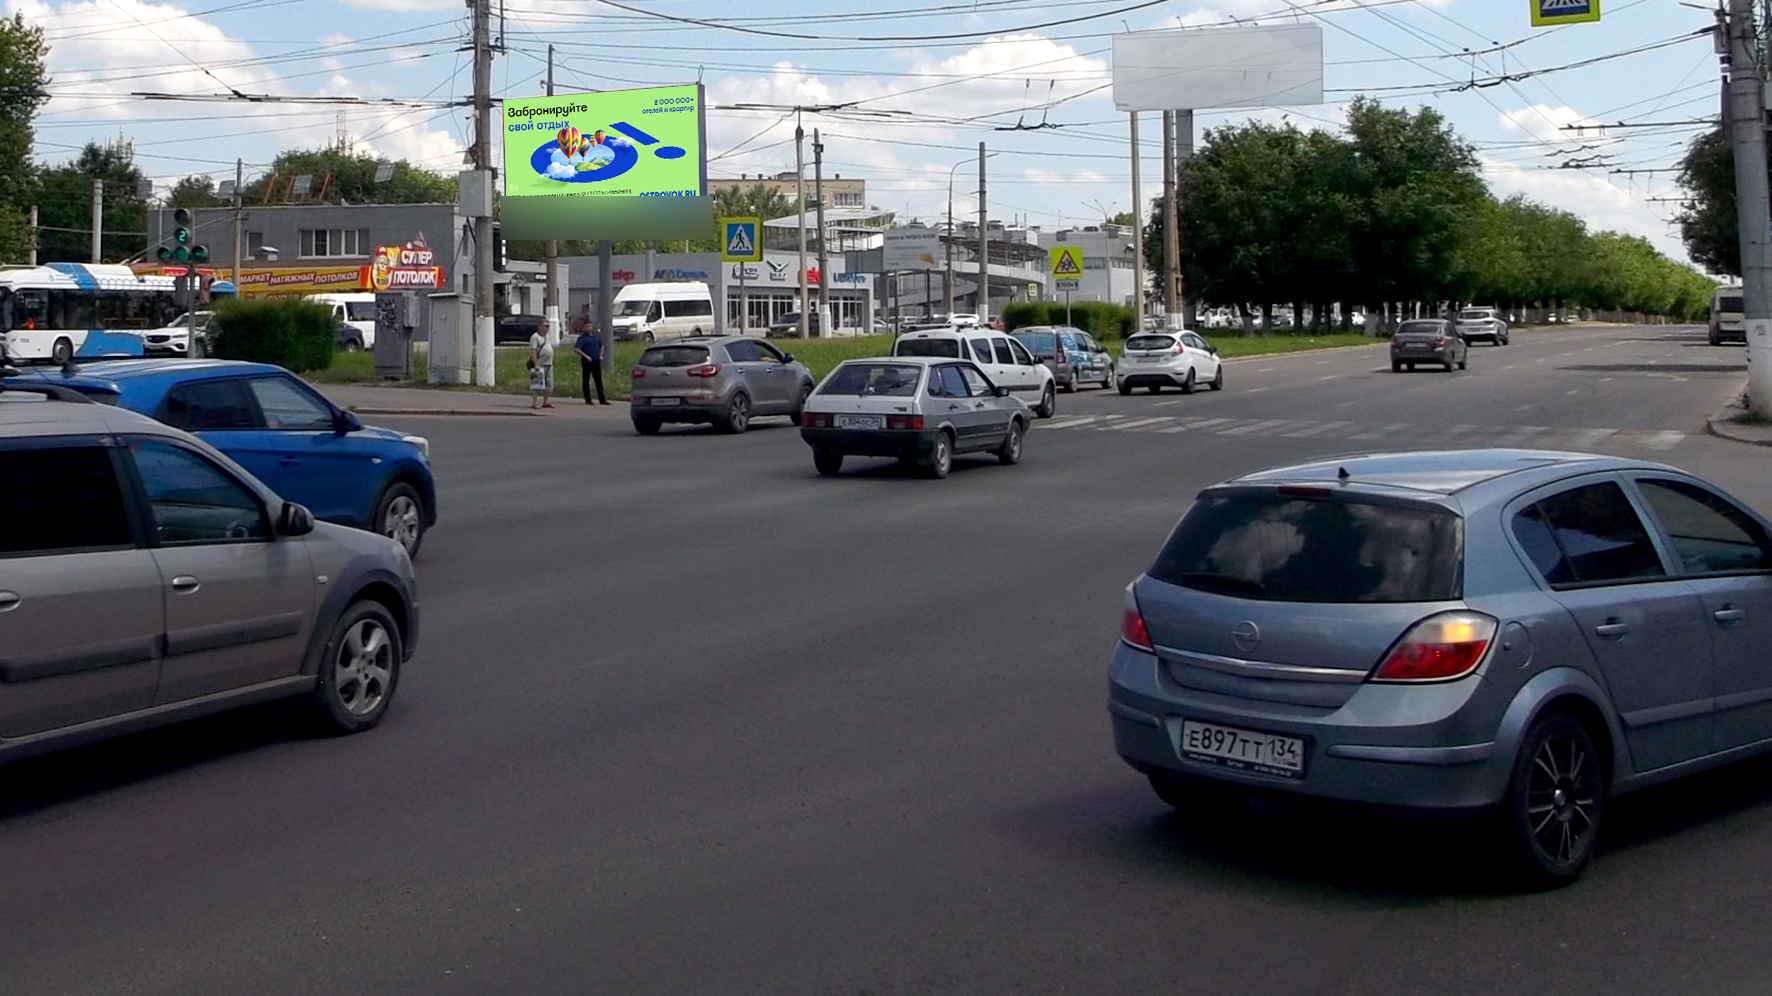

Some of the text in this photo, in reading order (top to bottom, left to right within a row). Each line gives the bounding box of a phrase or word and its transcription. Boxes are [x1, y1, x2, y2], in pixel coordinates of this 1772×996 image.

[507, 102, 588, 119] Забронируйте
[508, 120, 570, 132] свой отдых
[510, 184, 518, 192] 0+
[178, 231, 187, 243] 2
[401, 250, 433, 265] СУПЕР
[270, 272, 316, 285] НАТЯЖНЫХ
[315, 271, 358, 284] ПОТОЛКОВ
[392, 270, 436, 284] ПОТОЛОК
[1189, 728, 1297, 759] E897TT 134
